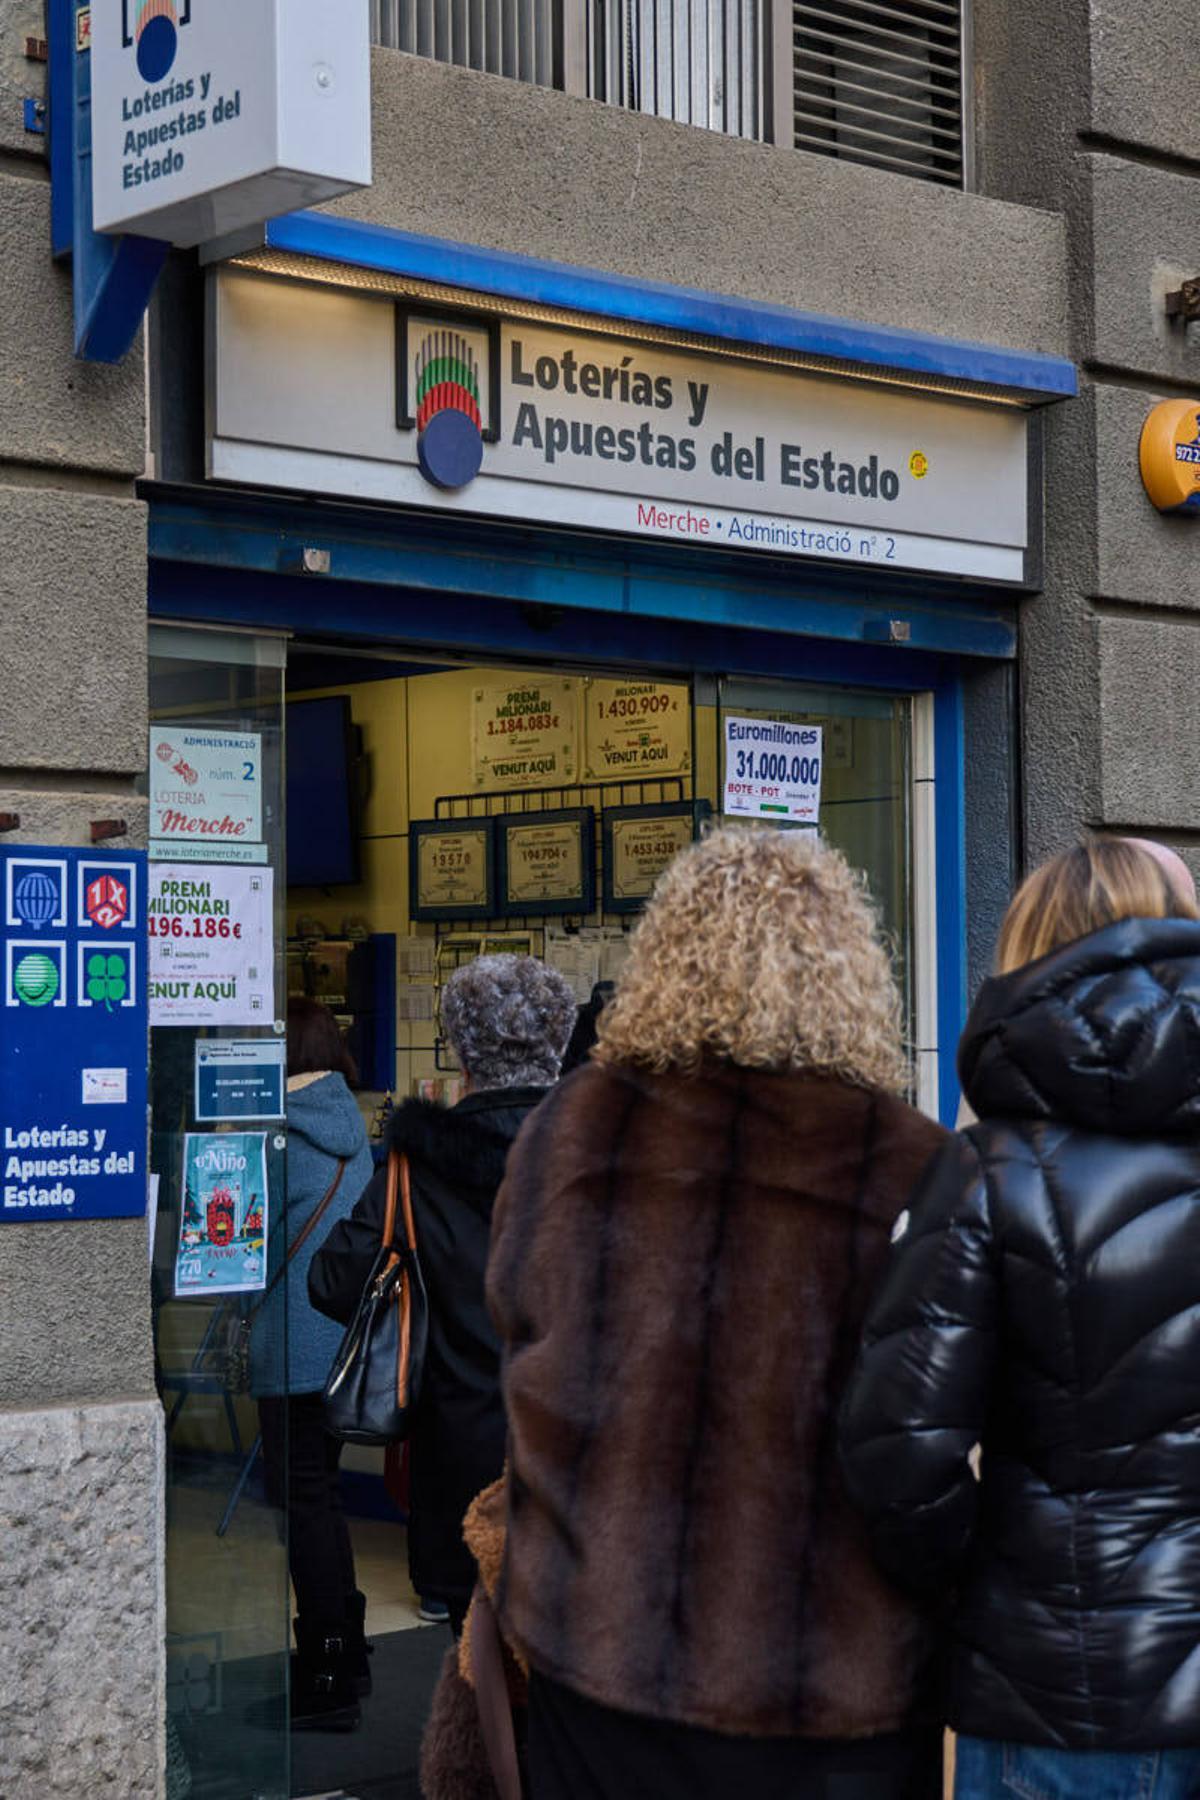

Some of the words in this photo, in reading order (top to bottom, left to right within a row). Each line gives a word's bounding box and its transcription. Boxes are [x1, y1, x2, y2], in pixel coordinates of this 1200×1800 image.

[122, 78, 194, 121] Loterías
[200, 72, 211, 99] y
[124, 109, 206, 157] Apuestas
[212, 91, 240, 125] del
[123, 149, 184, 189] Estado
[511, 340, 672, 410] Loterías
[687, 380, 708, 427] y
[512, 402, 696, 472] Apuestas
[711, 432, 765, 482] del
[780, 443, 899, 501] Estado
[637, 503, 710, 535] Merche
[728, 517, 851, 553] Administració
[885, 537, 895, 559] 2
[496, 700, 551, 718] MILIONARI
[507, 690, 540, 705] PREMI
[599, 694, 669, 719] 1.430.909
[728, 722, 817, 745] Euromillones
[243, 762, 255, 780] 2
[493, 762, 528, 776] VENUT
[736, 750, 820, 785] 31.000.000
[728, 783, 753, 795] BOTE
[761, 786, 780, 798] POT
[161, 880, 210, 897] PREMI
[5, 1124, 89, 1149] Loterías
[94, 1129, 107, 1152] y
[5, 1154, 100, 1183] Apuestas
[104, 1151, 135, 1174] del
[4, 1182, 75, 1208] Estado
